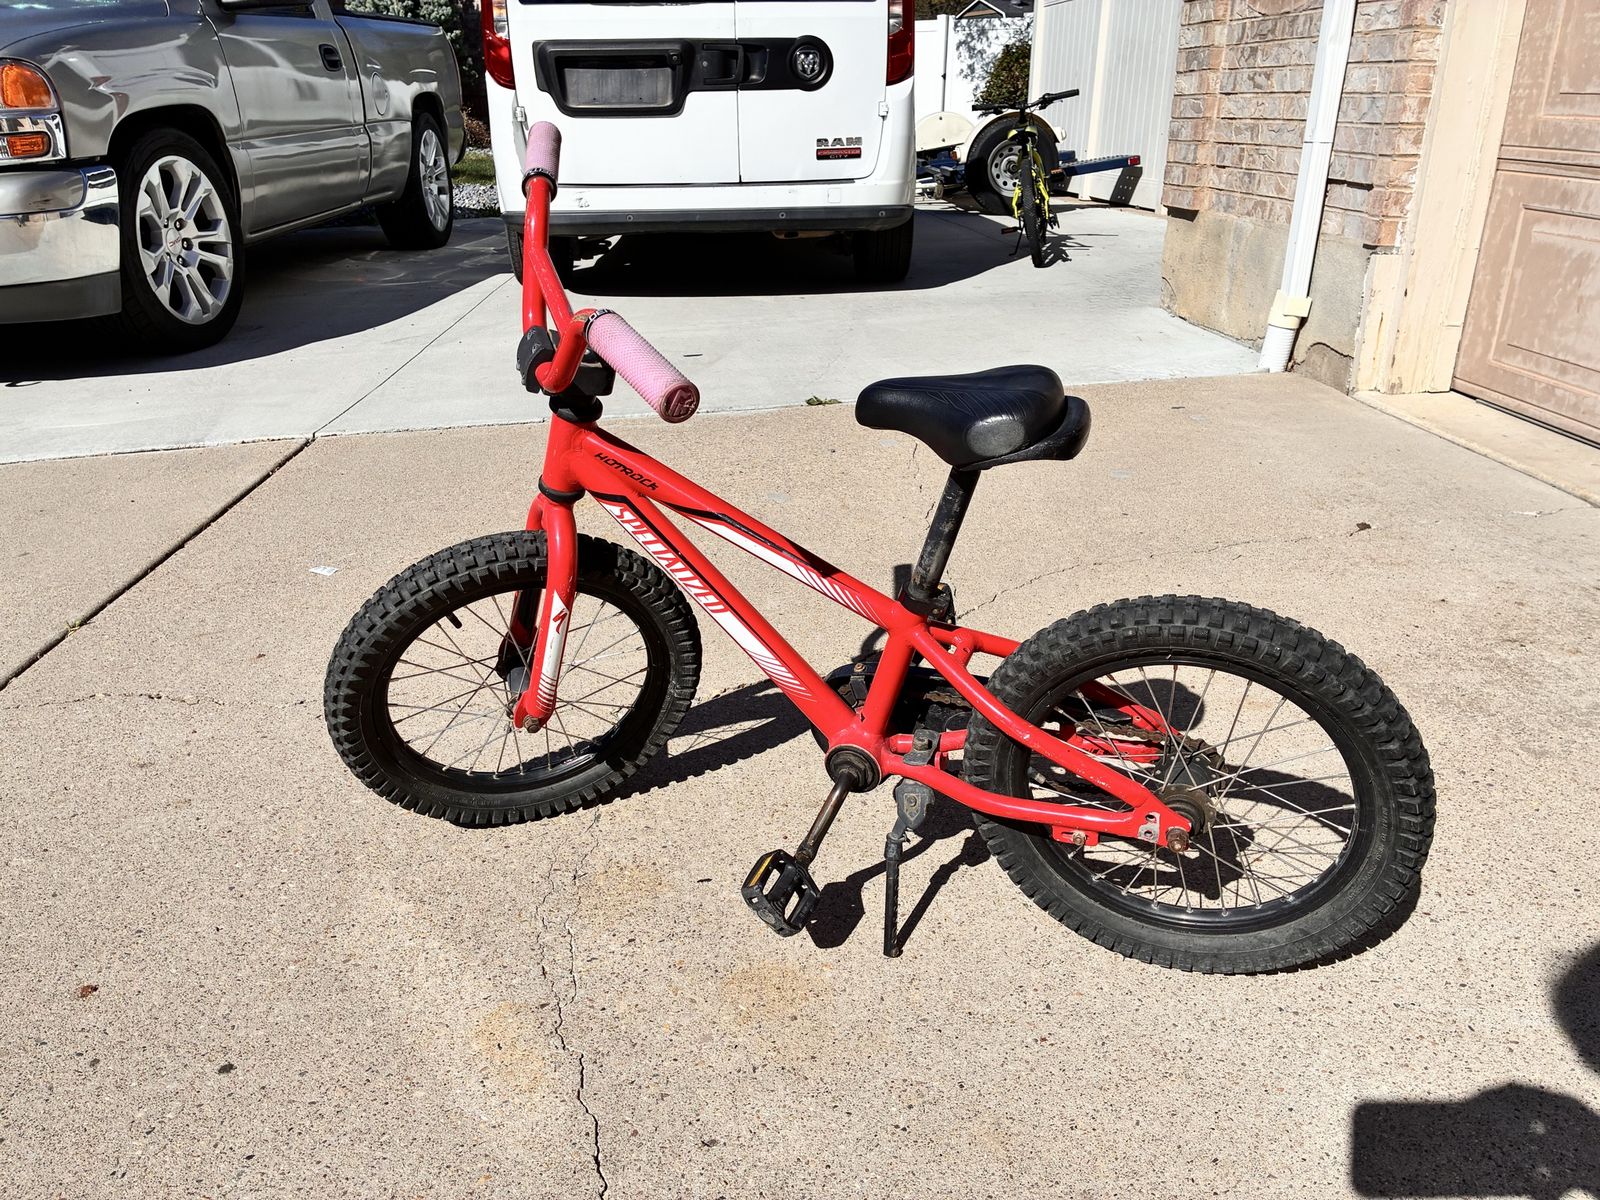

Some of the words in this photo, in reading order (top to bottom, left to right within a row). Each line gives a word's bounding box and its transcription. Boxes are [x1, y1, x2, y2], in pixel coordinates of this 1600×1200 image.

[816, 136, 863, 147] RAM
[594, 452, 659, 491] HOTROCK
[608, 506, 726, 614] SPECIALIZED
